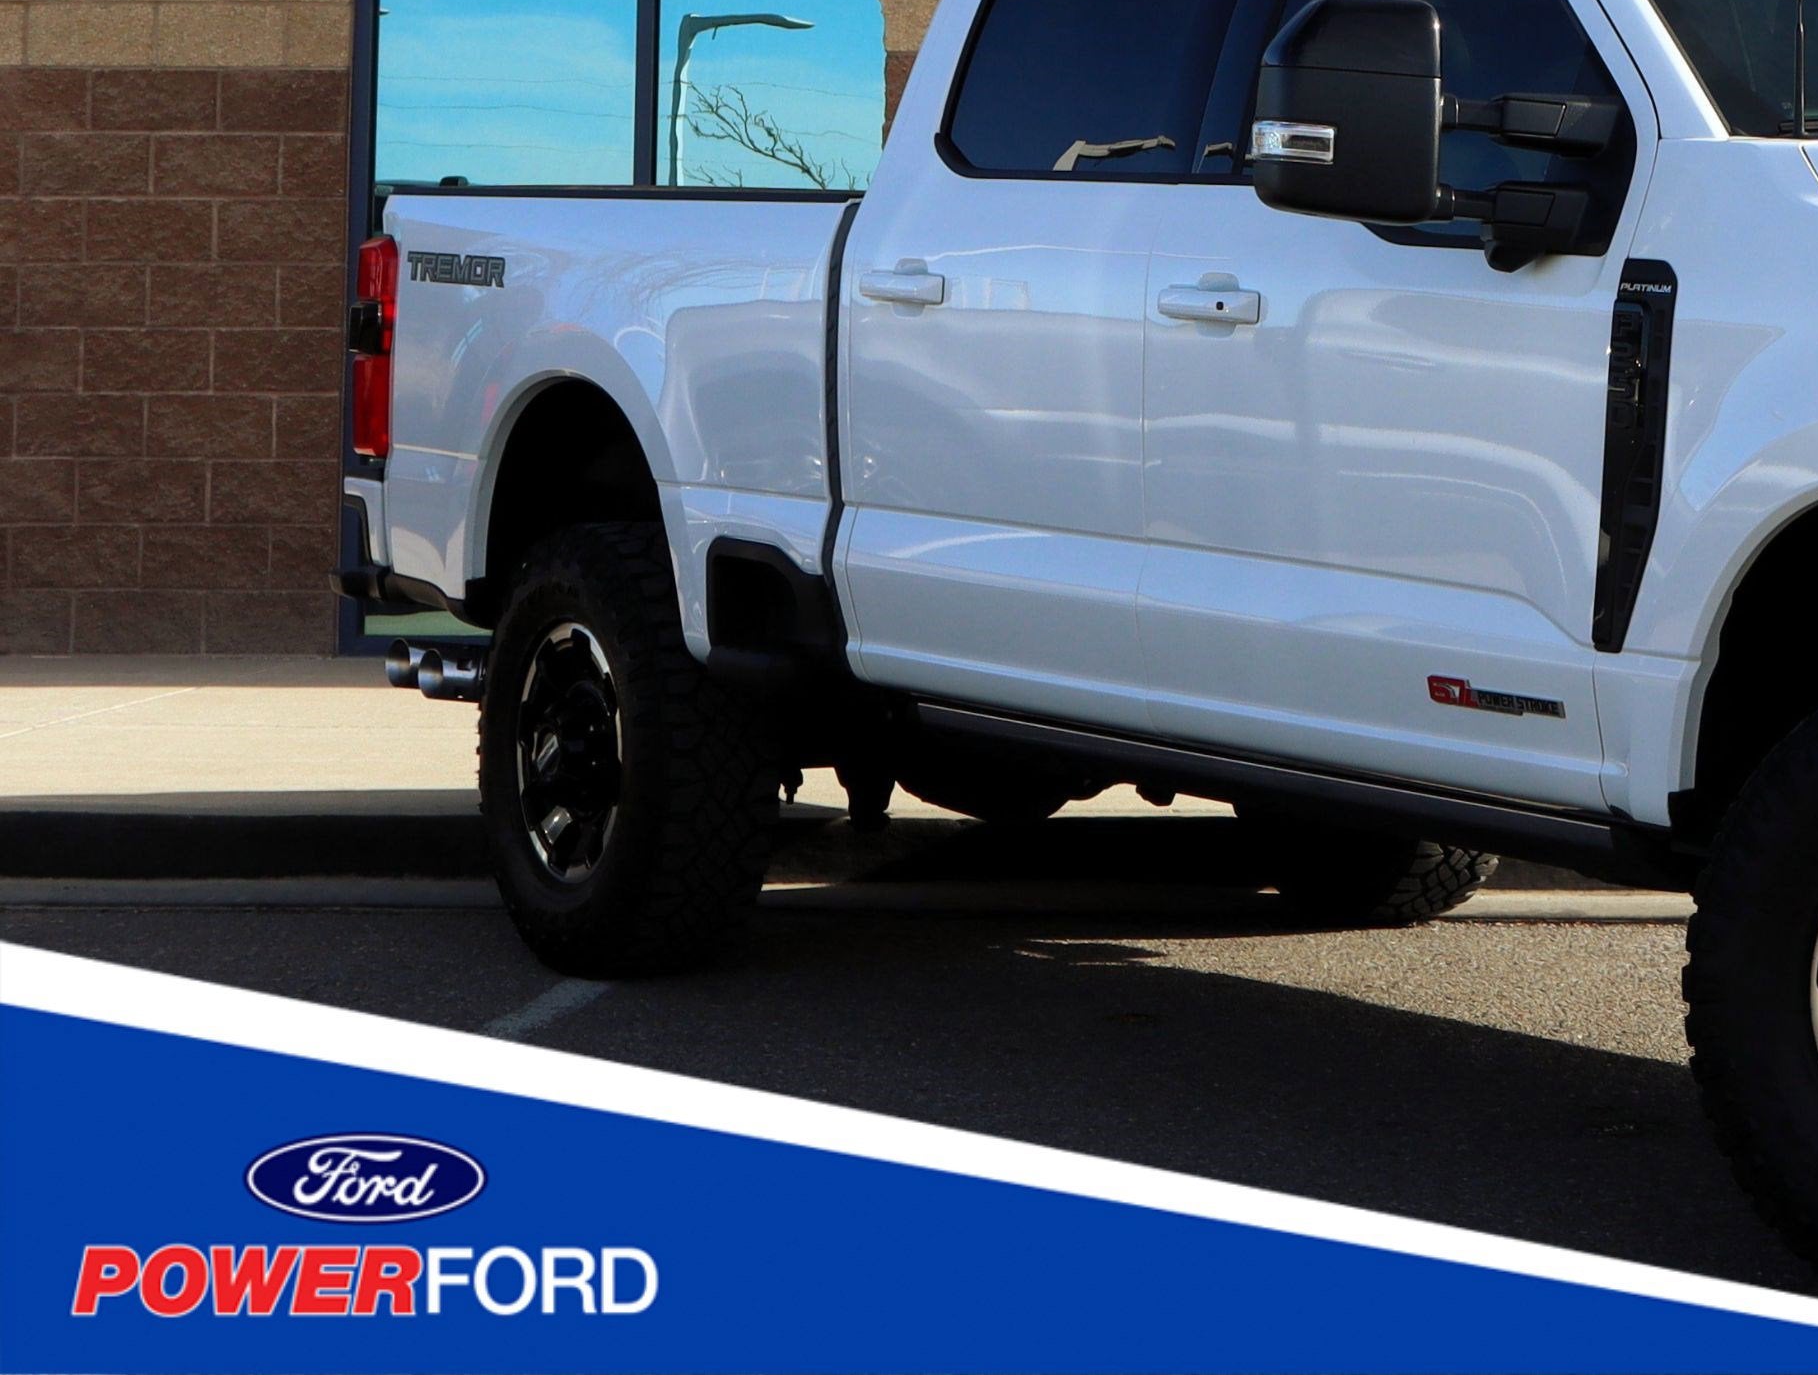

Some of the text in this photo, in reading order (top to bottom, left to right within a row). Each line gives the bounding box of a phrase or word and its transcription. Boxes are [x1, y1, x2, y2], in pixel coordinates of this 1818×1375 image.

[407, 250, 506, 289] TREMOR
[1620, 282, 1672, 294] PLATINUM
[1478, 694, 1560, 715] POWER STROKE
